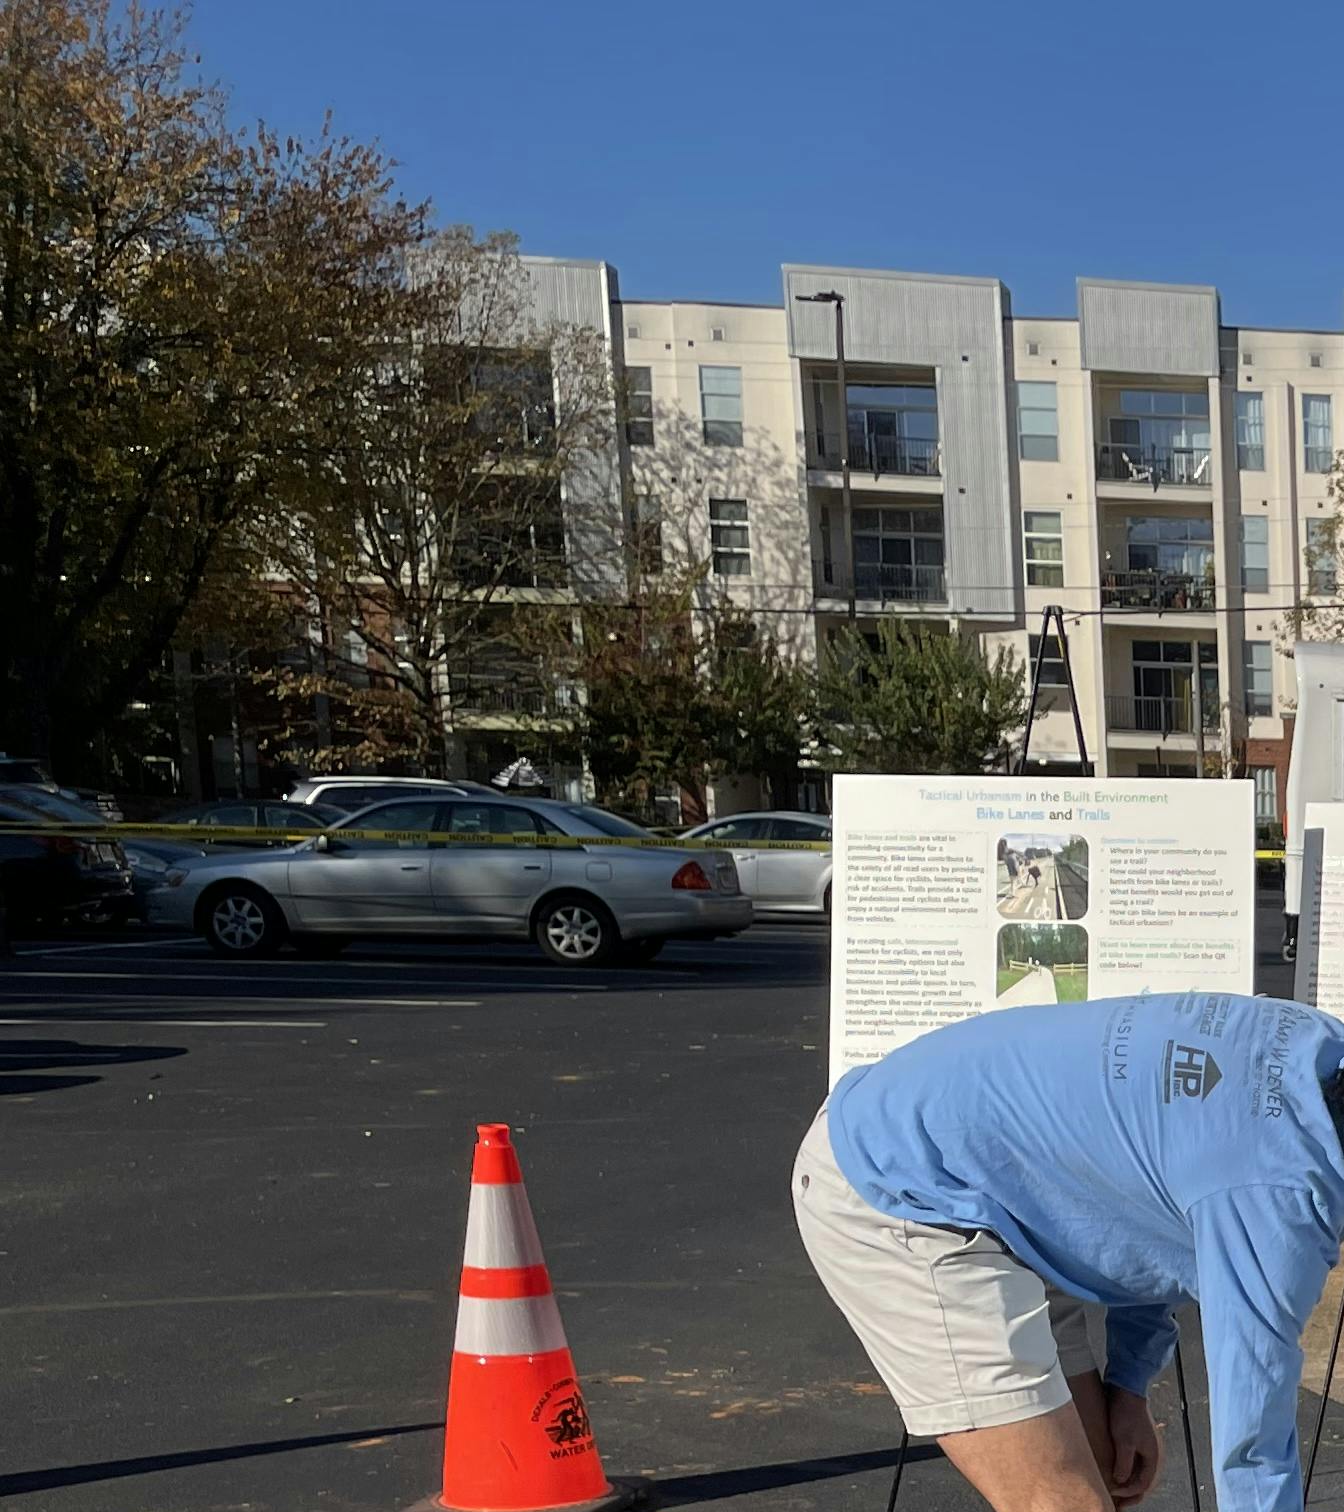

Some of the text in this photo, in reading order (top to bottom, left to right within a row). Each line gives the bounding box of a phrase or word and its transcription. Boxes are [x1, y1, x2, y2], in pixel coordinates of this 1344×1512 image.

[919, 790, 1168, 802] Tactical Urbanism in the Built Environment
[977, 809, 1110, 820] Bike Lanes and Trails
[550, 1443, 586, 1459] WATER
